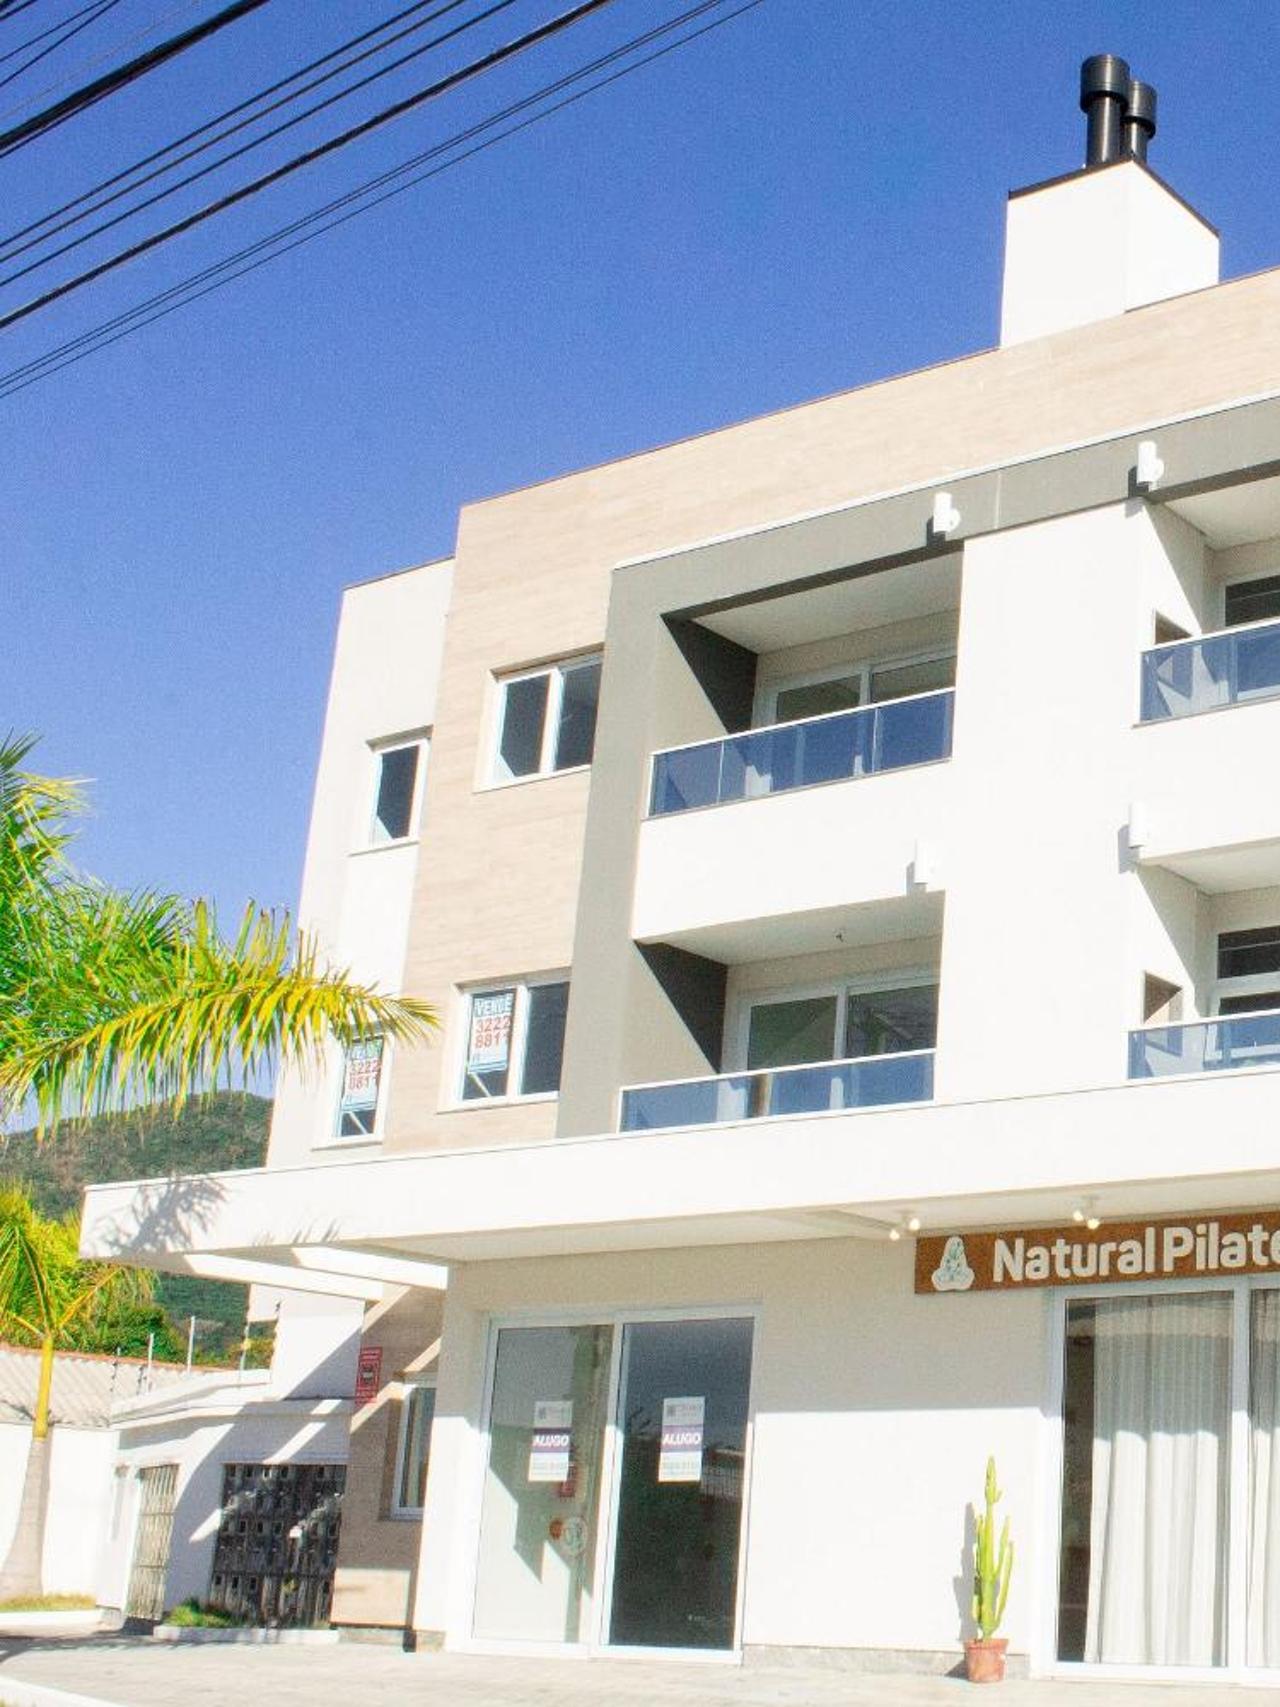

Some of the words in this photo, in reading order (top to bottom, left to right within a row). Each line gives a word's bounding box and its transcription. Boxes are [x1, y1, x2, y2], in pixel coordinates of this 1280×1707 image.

[993, 1227, 1156, 1282] Natural
[532, 1434, 570, 1448] ALUGO
[661, 1431, 701, 1446] ALUGO
